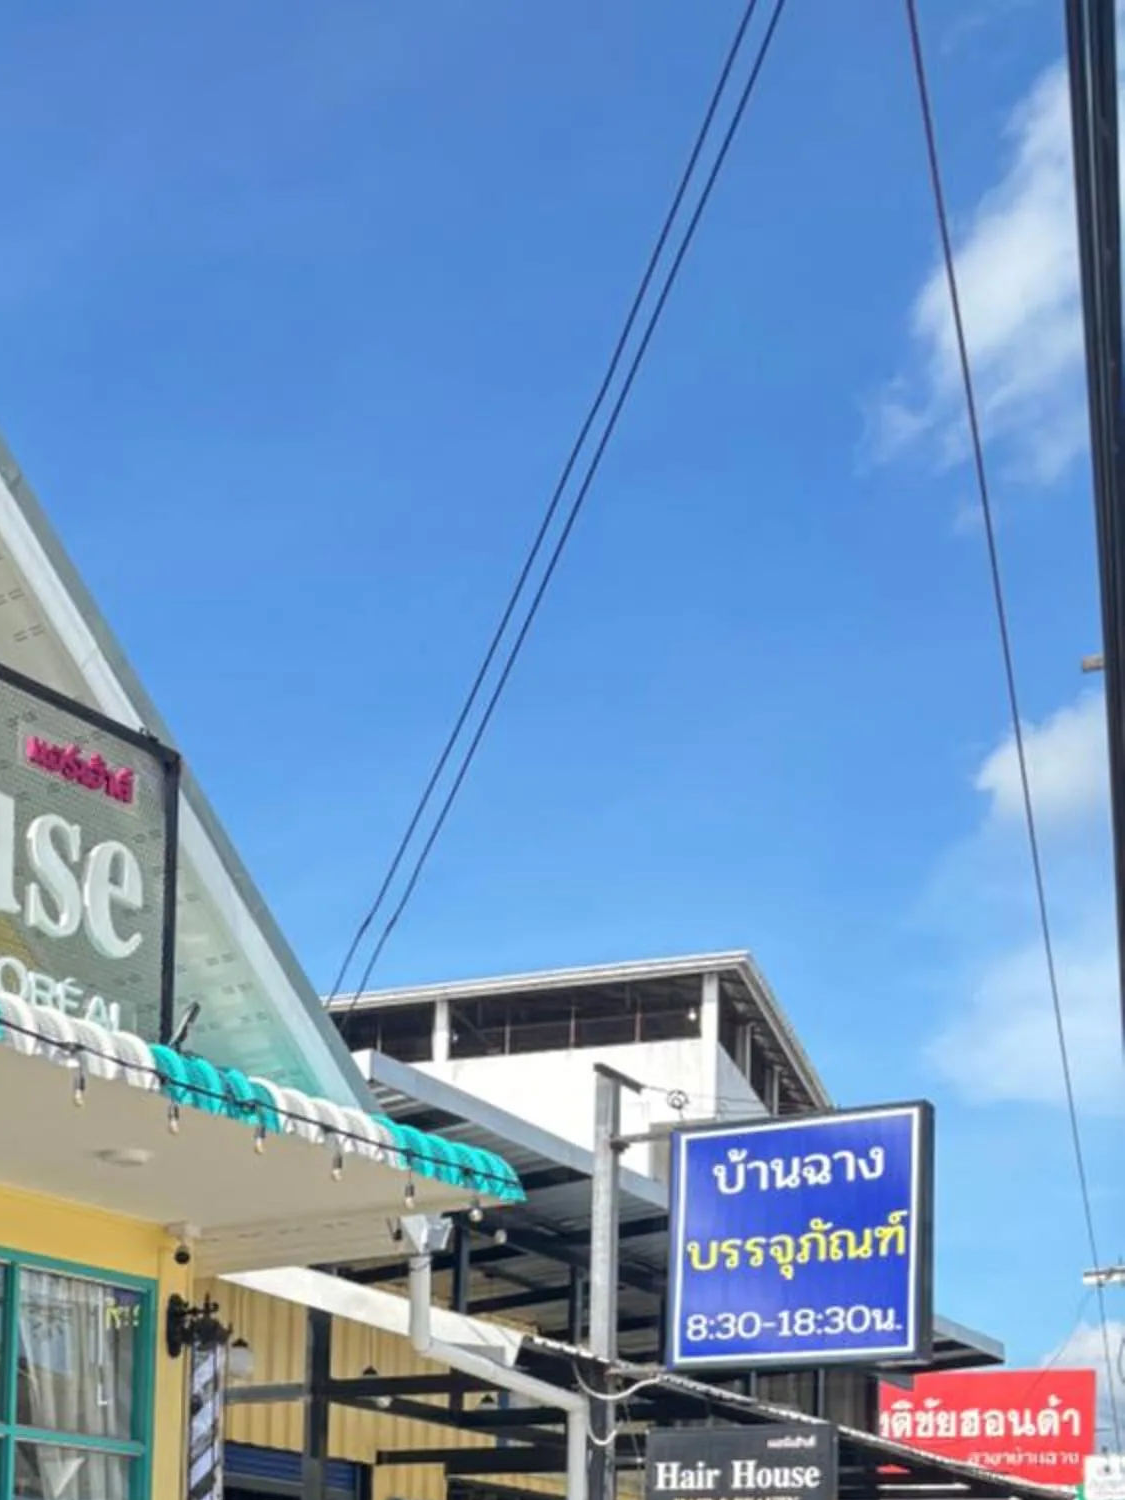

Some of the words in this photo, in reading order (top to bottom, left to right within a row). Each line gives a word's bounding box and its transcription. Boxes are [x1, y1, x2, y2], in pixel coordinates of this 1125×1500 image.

[712, 1146, 885, 1194] บ้านฉาง
[686, 1210, 908, 1280] บรรจุภัณฑ์
[686, 1305, 903, 1342] 8:30-18:30น.
[654, 1460, 722, 1490] Hair
[731, 1459, 822, 1490] House
